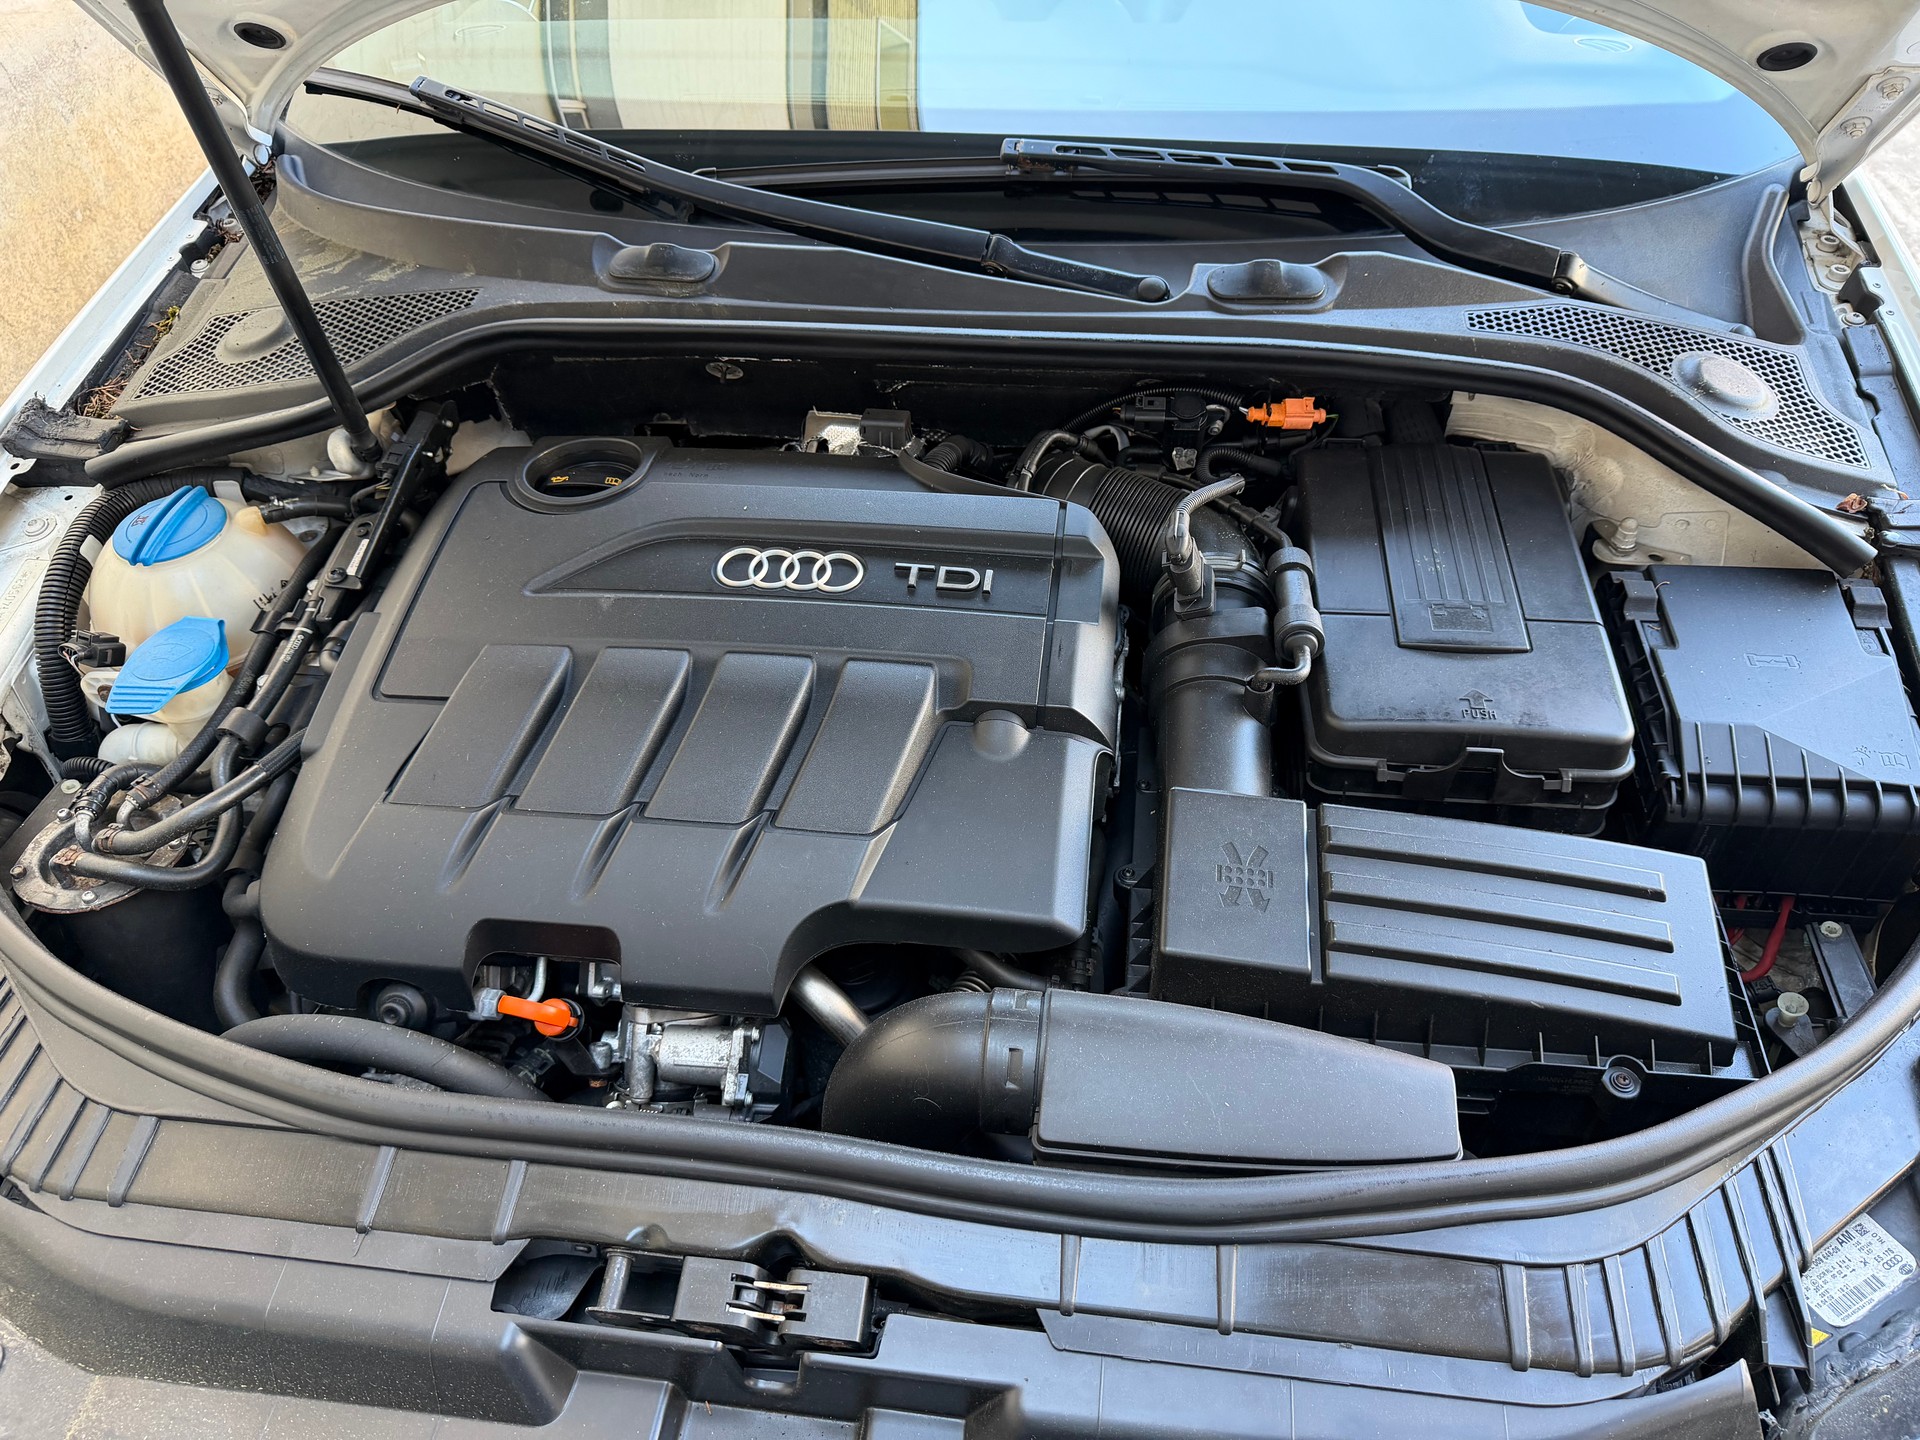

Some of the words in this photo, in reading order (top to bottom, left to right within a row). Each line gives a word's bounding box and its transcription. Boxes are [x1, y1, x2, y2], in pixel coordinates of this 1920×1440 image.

[894, 562, 994, 595] TDI
[1461, 709, 1498, 720] PUSH
[1836, 1229, 1856, 1247] AM
